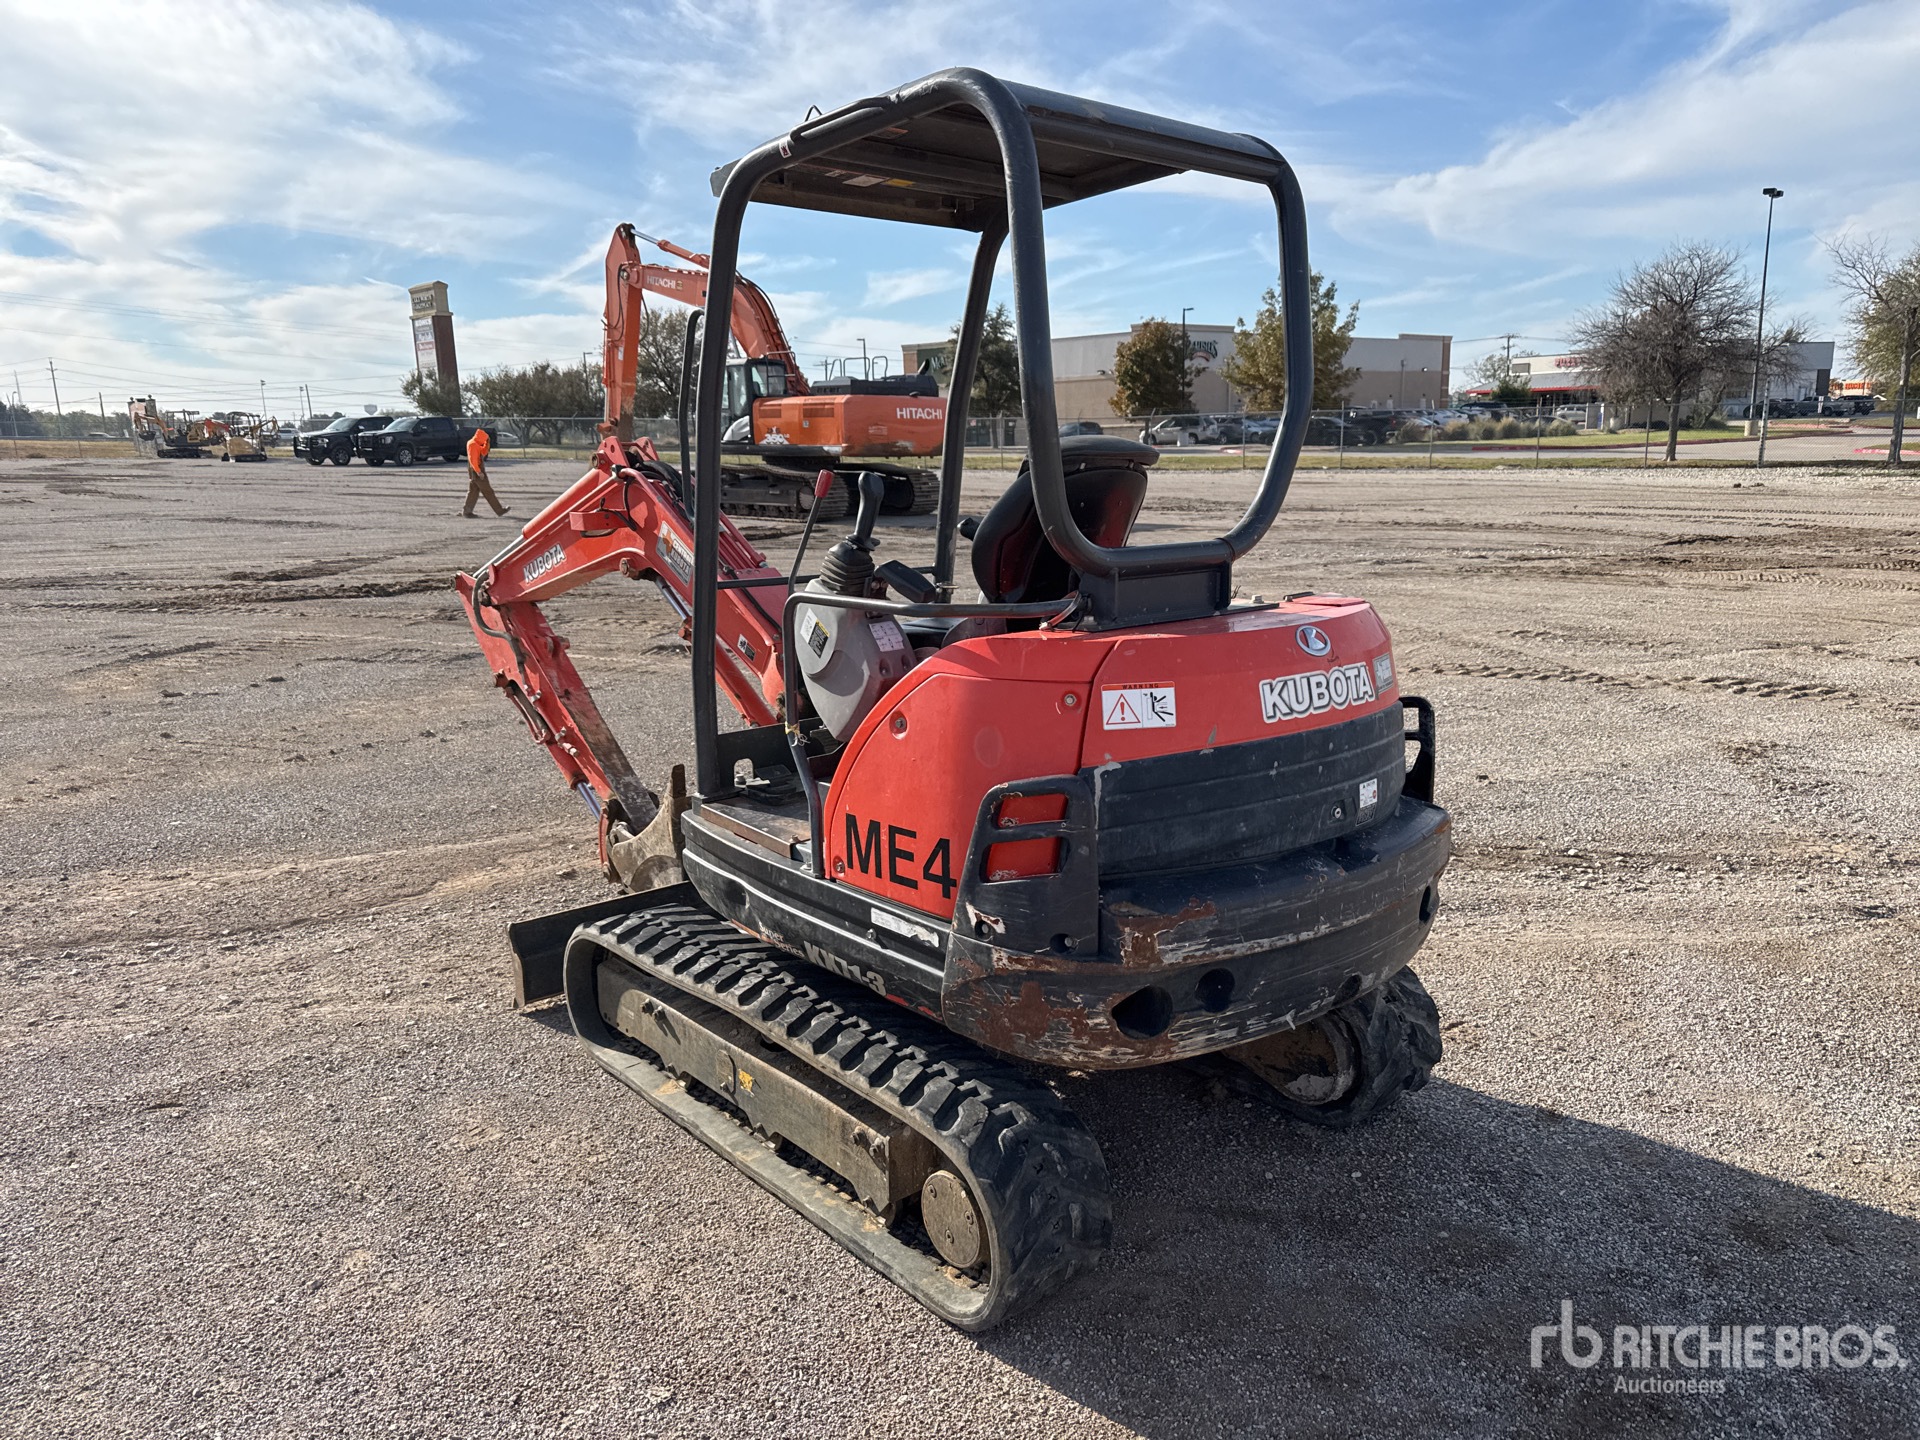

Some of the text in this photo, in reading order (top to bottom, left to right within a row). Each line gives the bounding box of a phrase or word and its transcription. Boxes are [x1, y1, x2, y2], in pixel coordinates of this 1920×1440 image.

[646, 275, 677, 289] HITACHI
[896, 407, 943, 420] HITACHI
[523, 543, 566, 584] KUBOTA
[1259, 662, 1375, 722] KUBOTA
[846, 813, 957, 899] ME4
